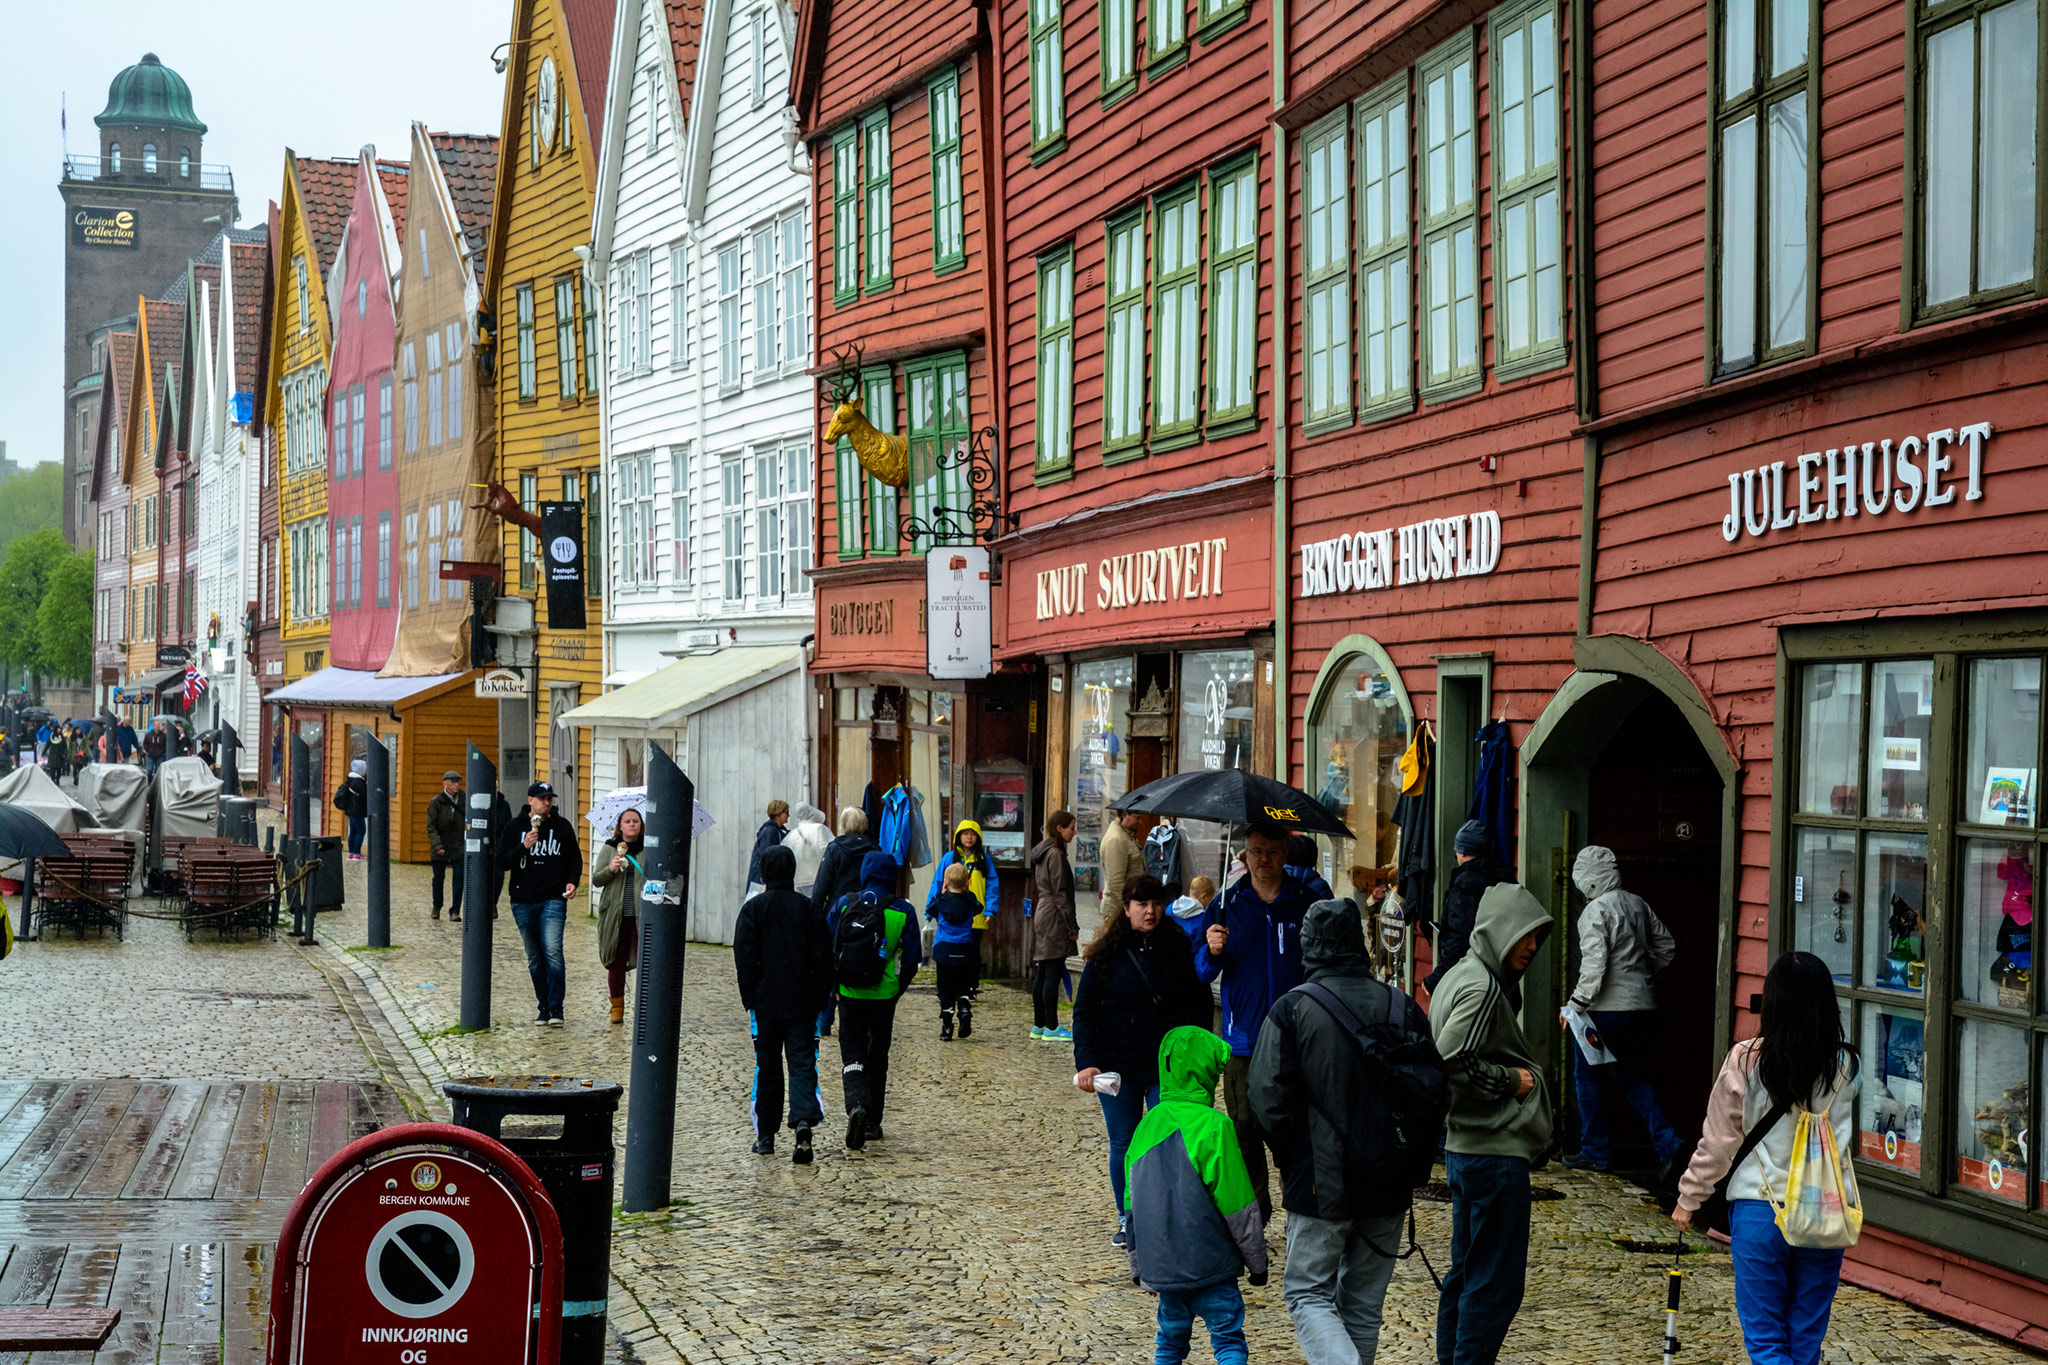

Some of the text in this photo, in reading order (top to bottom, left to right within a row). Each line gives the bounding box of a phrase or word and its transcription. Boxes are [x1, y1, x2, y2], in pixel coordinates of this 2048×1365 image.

[75, 211, 115, 226] Clarion
[84, 226, 134, 238] Collection
[1722, 422, 1991, 541] JULEHUSET
[1300, 510, 1501, 597] BRYGGEN HUSFLID
[1036, 537, 1227, 620] KNUT SKURTVEIT
[830, 599, 893, 635] BRYGGEN
[479, 681, 524, 692] To Kokker
[1201, 739, 1226, 754] AUDHILD
[1204, 754, 1221, 769] VIKEN
[379, 1196, 470, 1206] BERGEN KOMMUNE
[362, 1328, 469, 1343] INNKJØRING
[400, 1350, 427, 1364] OG
